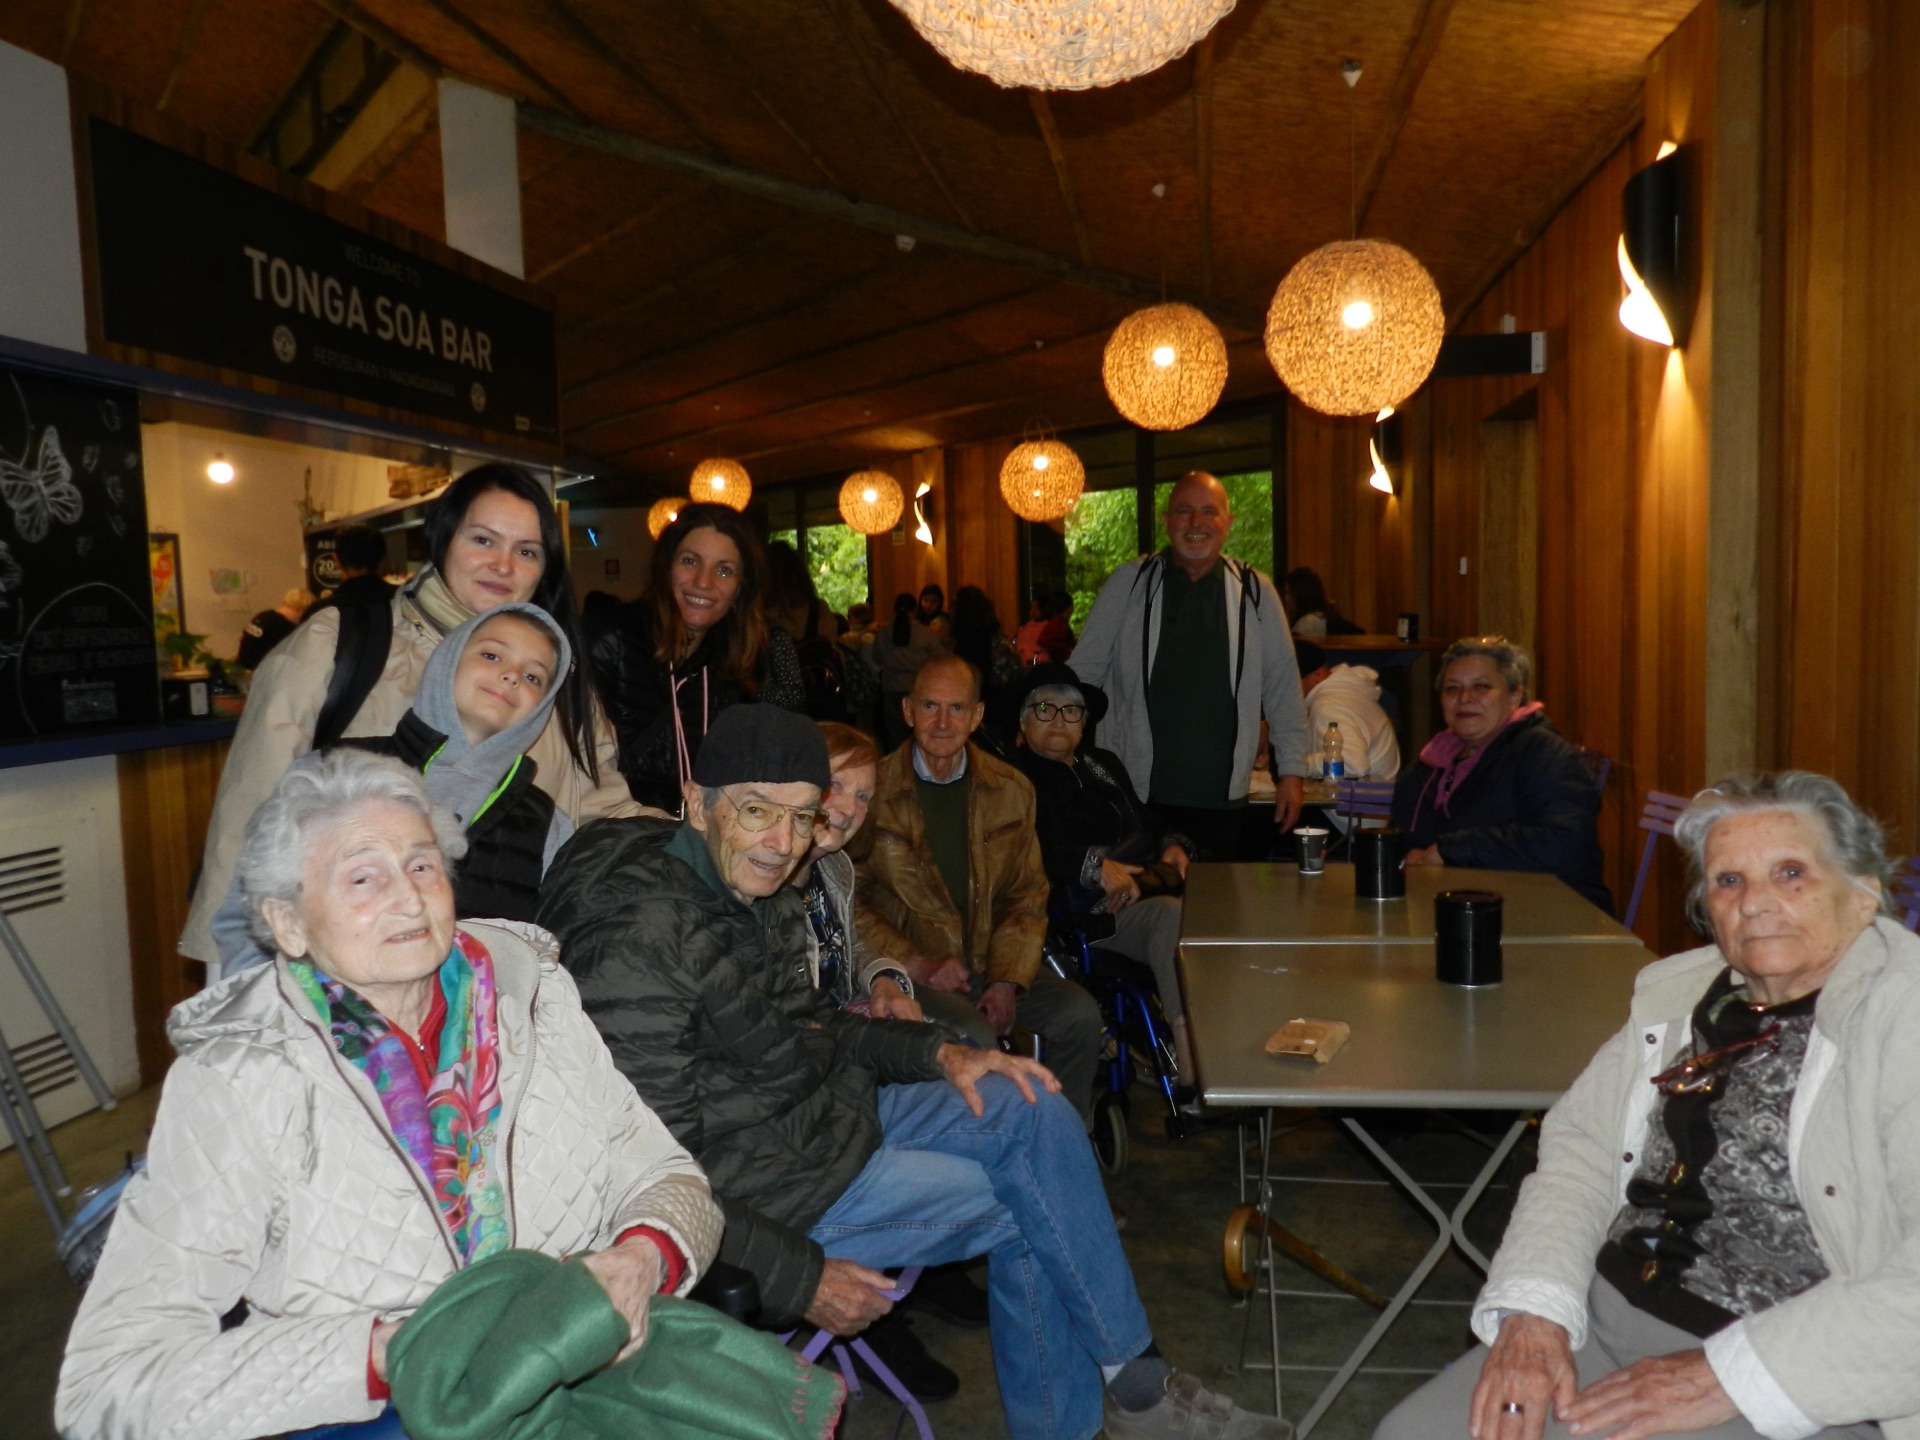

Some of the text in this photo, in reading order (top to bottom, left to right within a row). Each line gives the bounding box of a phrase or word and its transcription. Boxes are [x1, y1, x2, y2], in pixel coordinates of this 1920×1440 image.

[243, 245, 493, 373] TONGA SOA BAR
